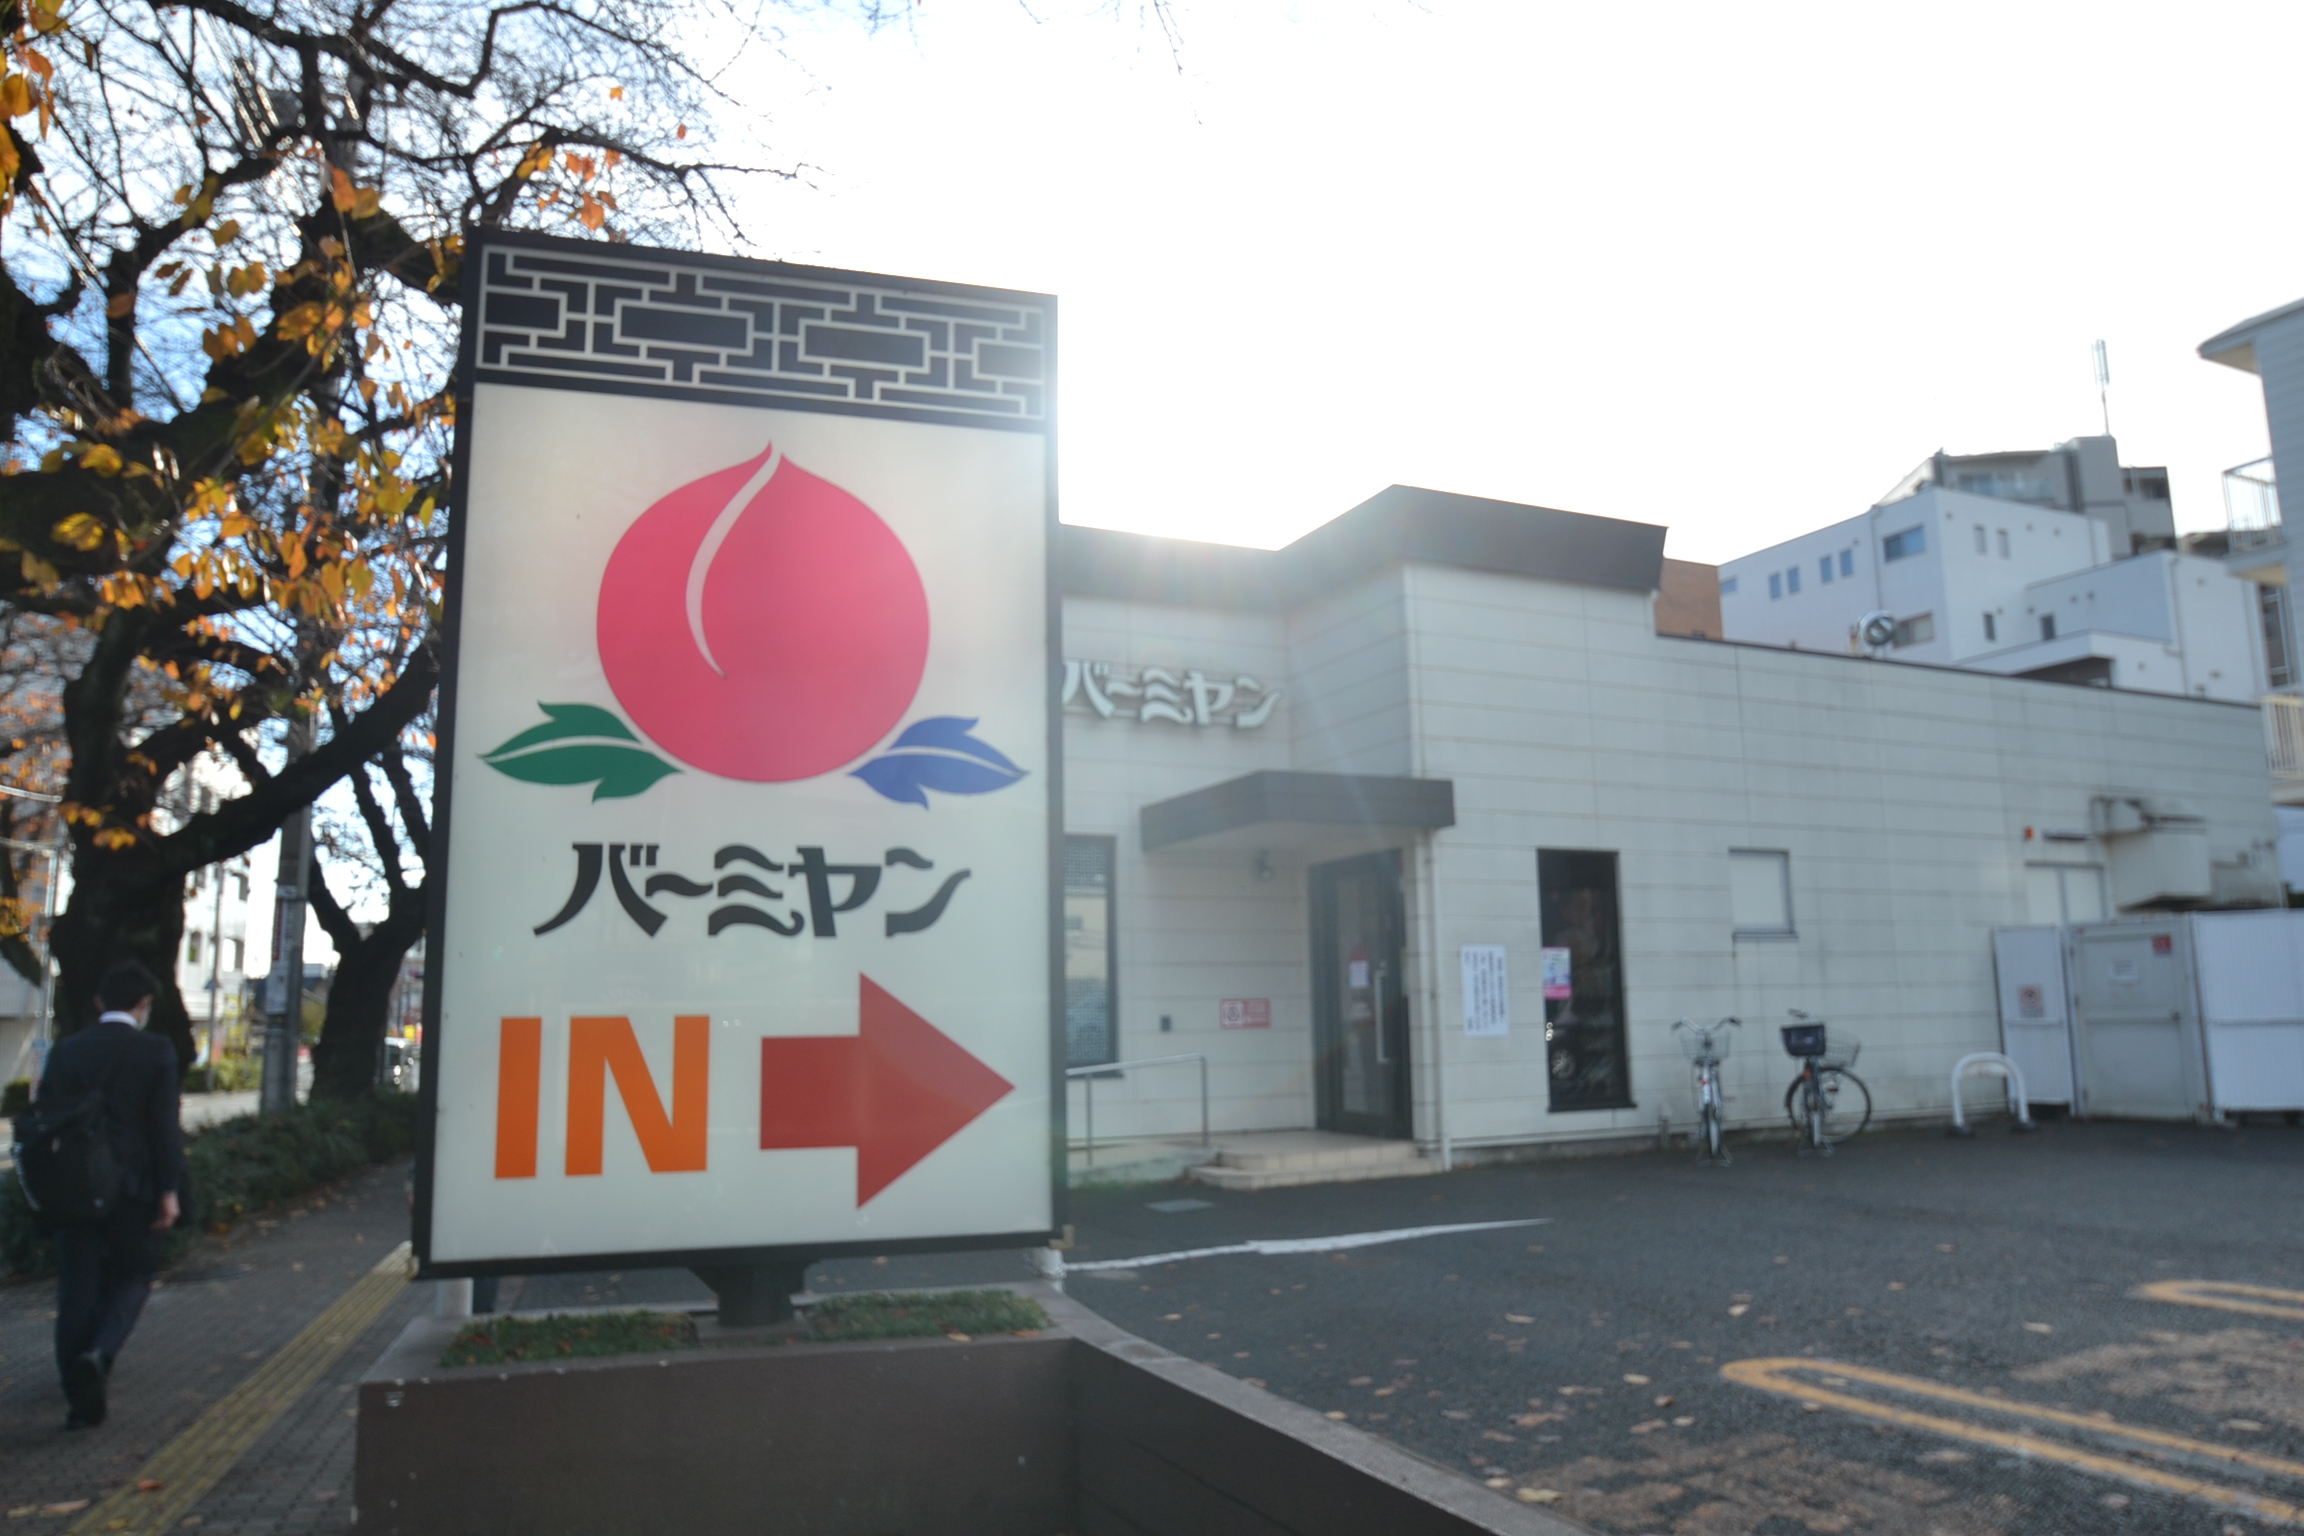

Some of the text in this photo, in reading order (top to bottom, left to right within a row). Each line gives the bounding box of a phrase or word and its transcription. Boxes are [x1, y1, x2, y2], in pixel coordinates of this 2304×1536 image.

[1063, 660, 1281, 728] バーミヤン
[532, 842, 971, 938] バーミヤン
[495, 1015, 710, 1179] IN
